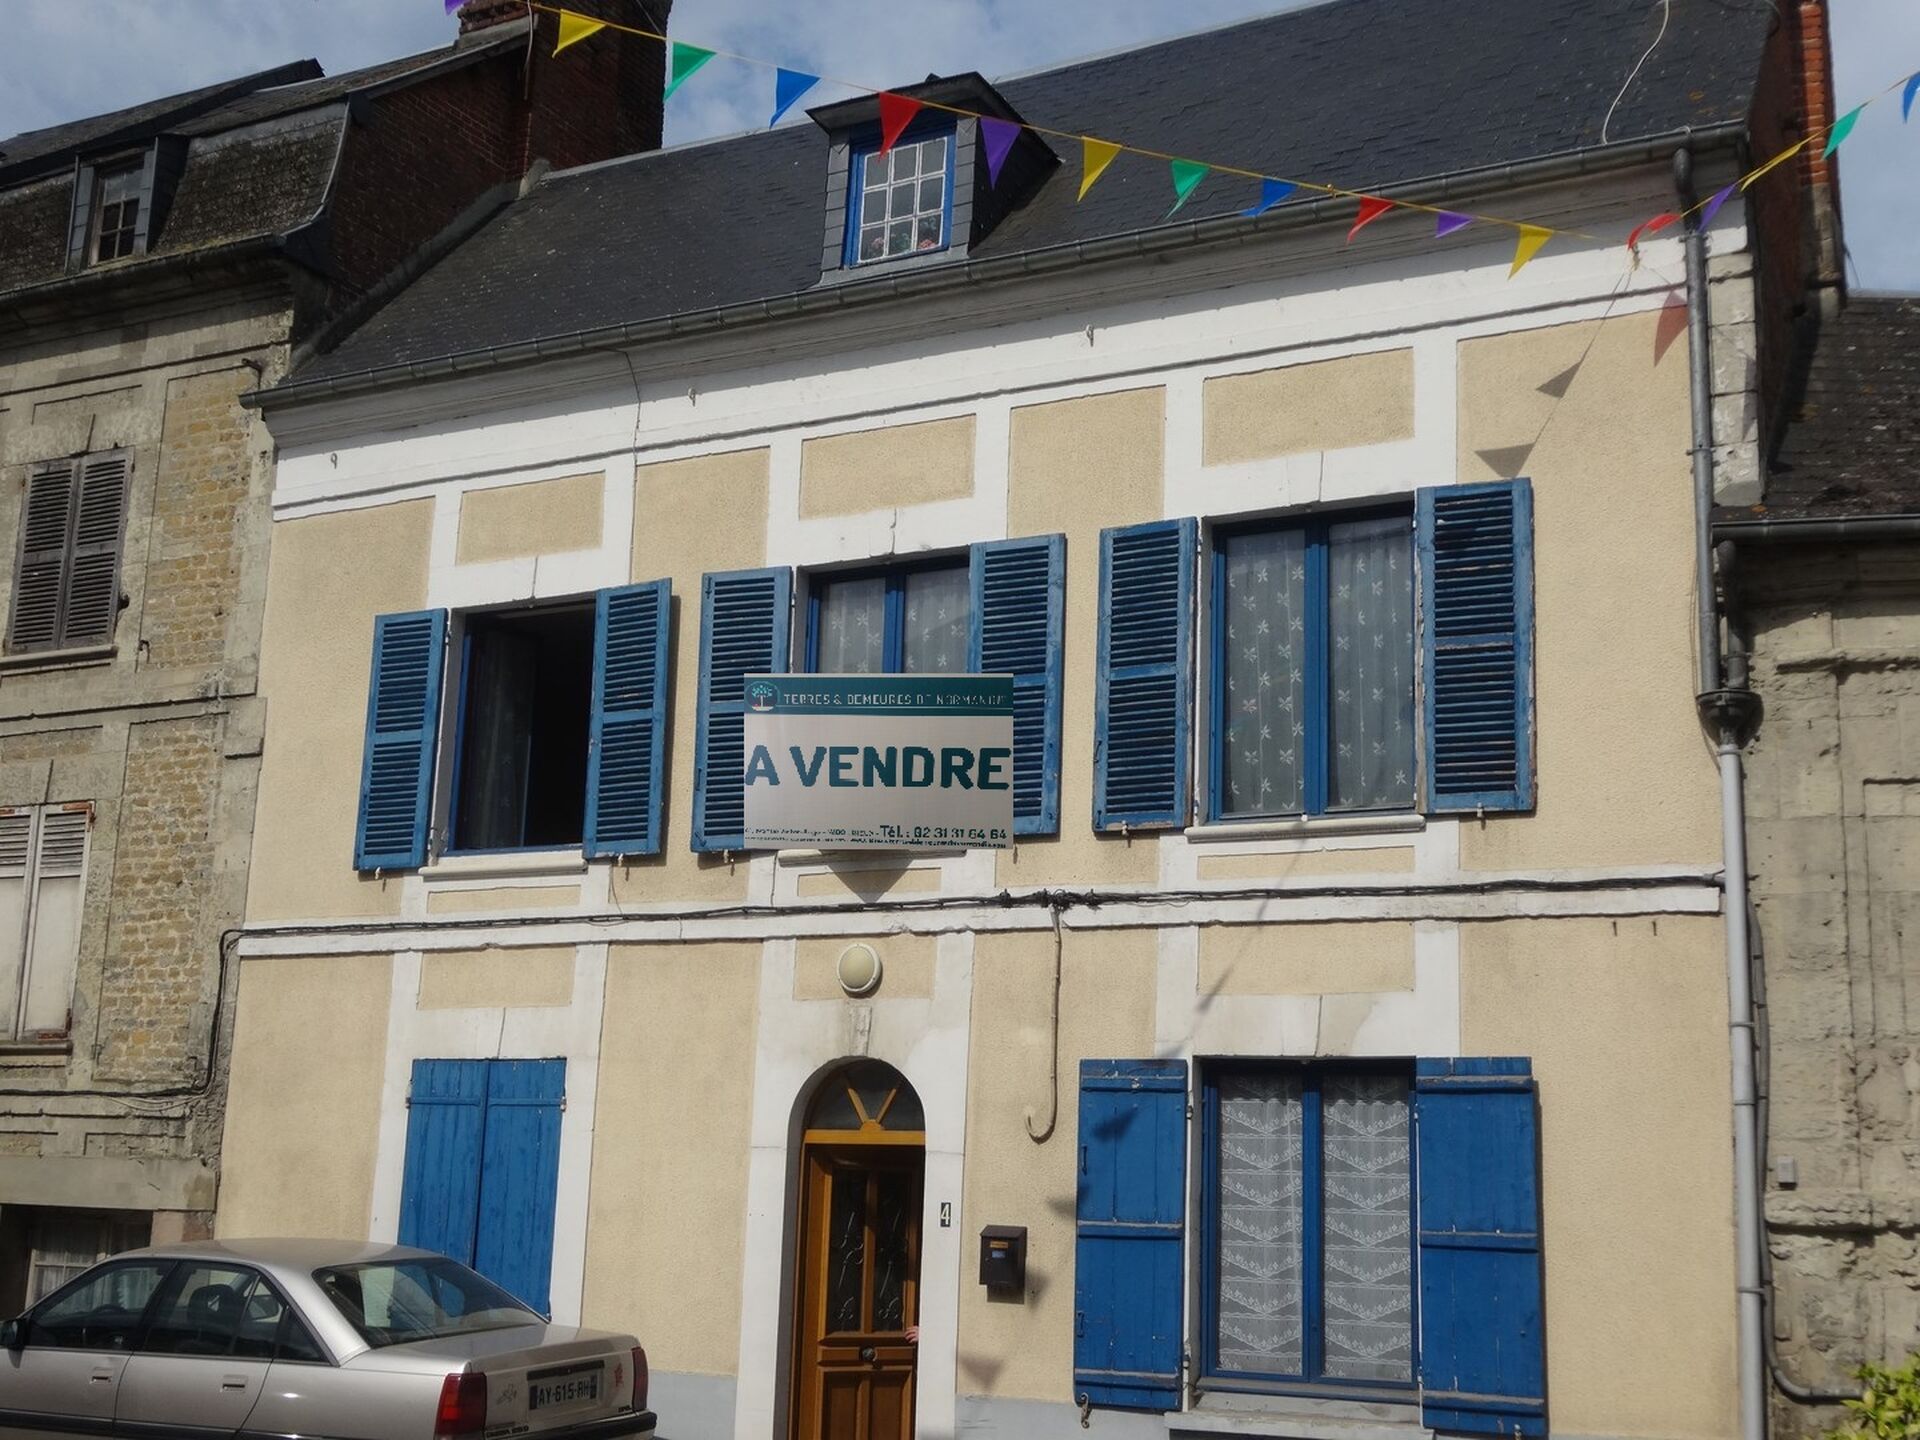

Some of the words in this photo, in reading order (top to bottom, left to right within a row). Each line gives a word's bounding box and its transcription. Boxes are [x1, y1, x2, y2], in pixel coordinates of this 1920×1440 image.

[784, 694, 830, 705] TERRES
[833, 694, 842, 705] &
[847, 694, 912, 705] DEMEURES
[917, 694, 932, 705] D
[745, 744, 780, 786] A
[789, 745, 1011, 790] VENDRE
[914, 826, 931, 838] 02
[934, 827, 947, 838] 31
[951, 828, 964, 838] 31
[941, 1203, 950, 1226] 4
